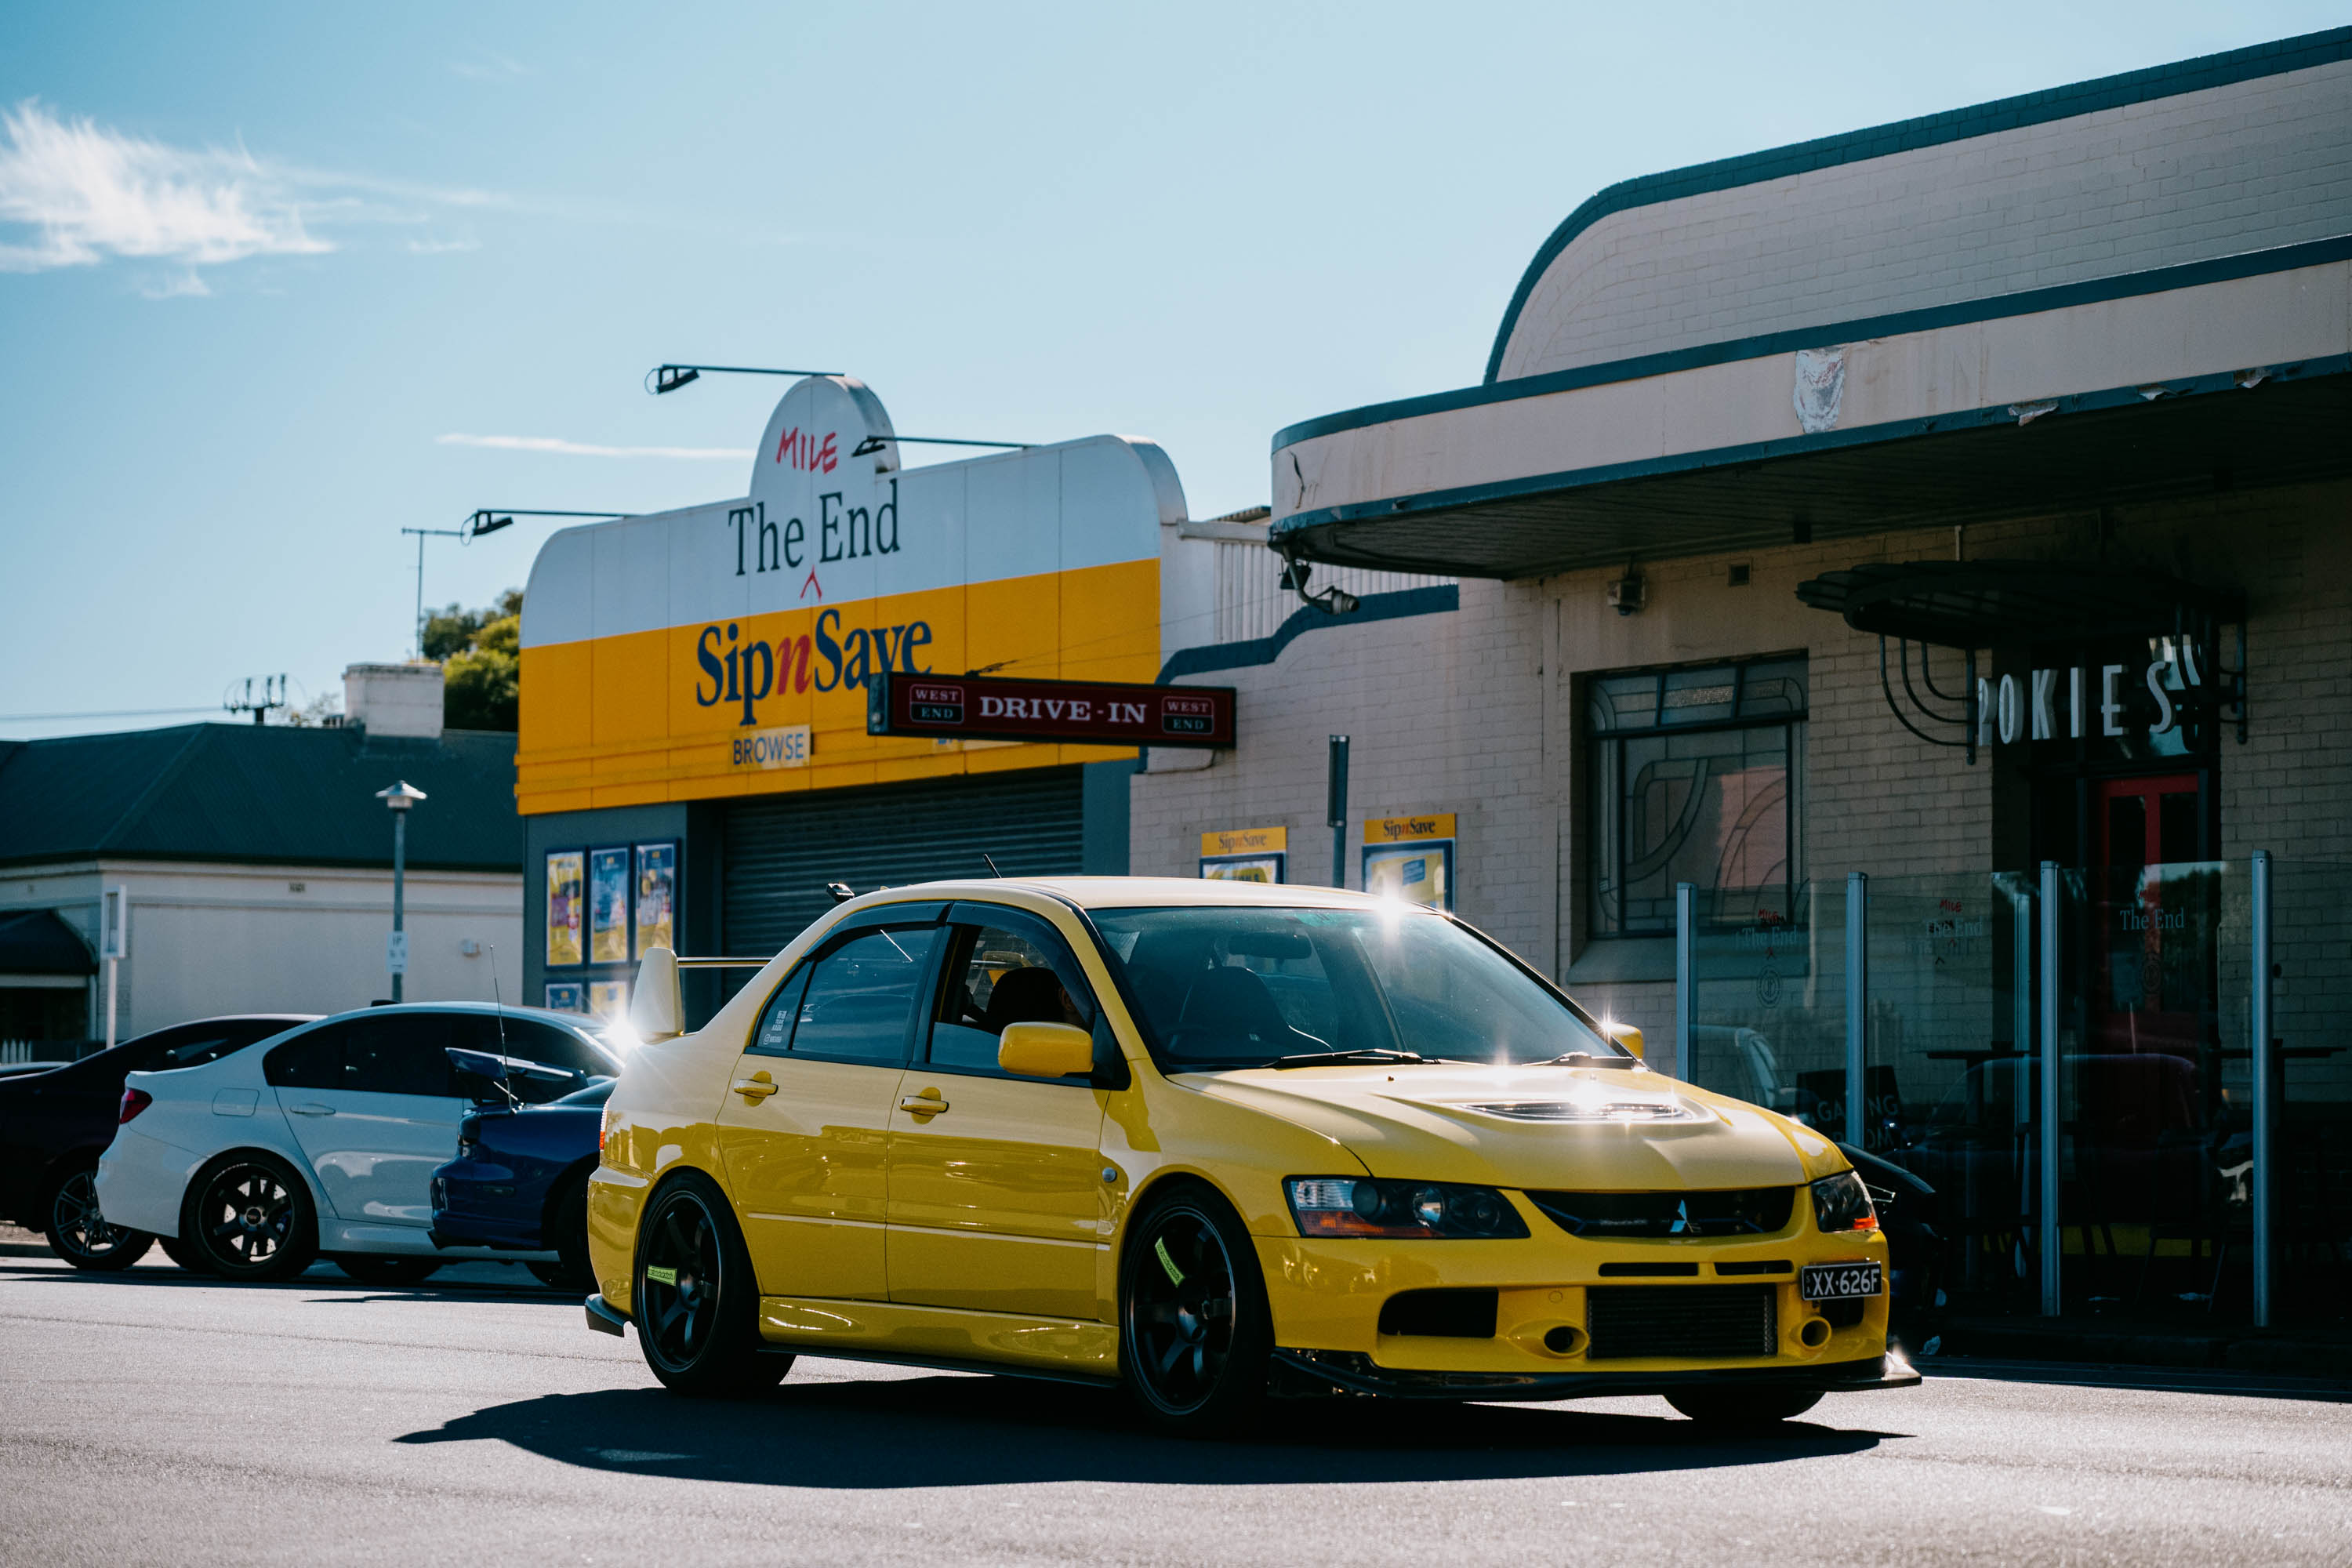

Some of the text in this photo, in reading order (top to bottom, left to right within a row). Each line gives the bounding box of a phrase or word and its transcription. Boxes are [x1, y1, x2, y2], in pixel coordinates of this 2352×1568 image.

[775, 426, 837, 474] MILE
[728, 477, 900, 576] The End
[696, 608, 933, 727] SipnSave
[914, 688, 960, 702] WEST
[1166, 699, 1210, 713] WEST
[1977, 660, 2176, 746] POKIES
[920, 708, 954, 720] END
[1172, 718, 1205, 731] END
[732, 733, 804, 766] BROWSE
[1218, 832, 1268, 851] SipnSave
[1382, 818, 1436, 840] SipnSave
[2119, 904, 2185, 931] The End
[1817, 1093, 1899, 1123] GANG
